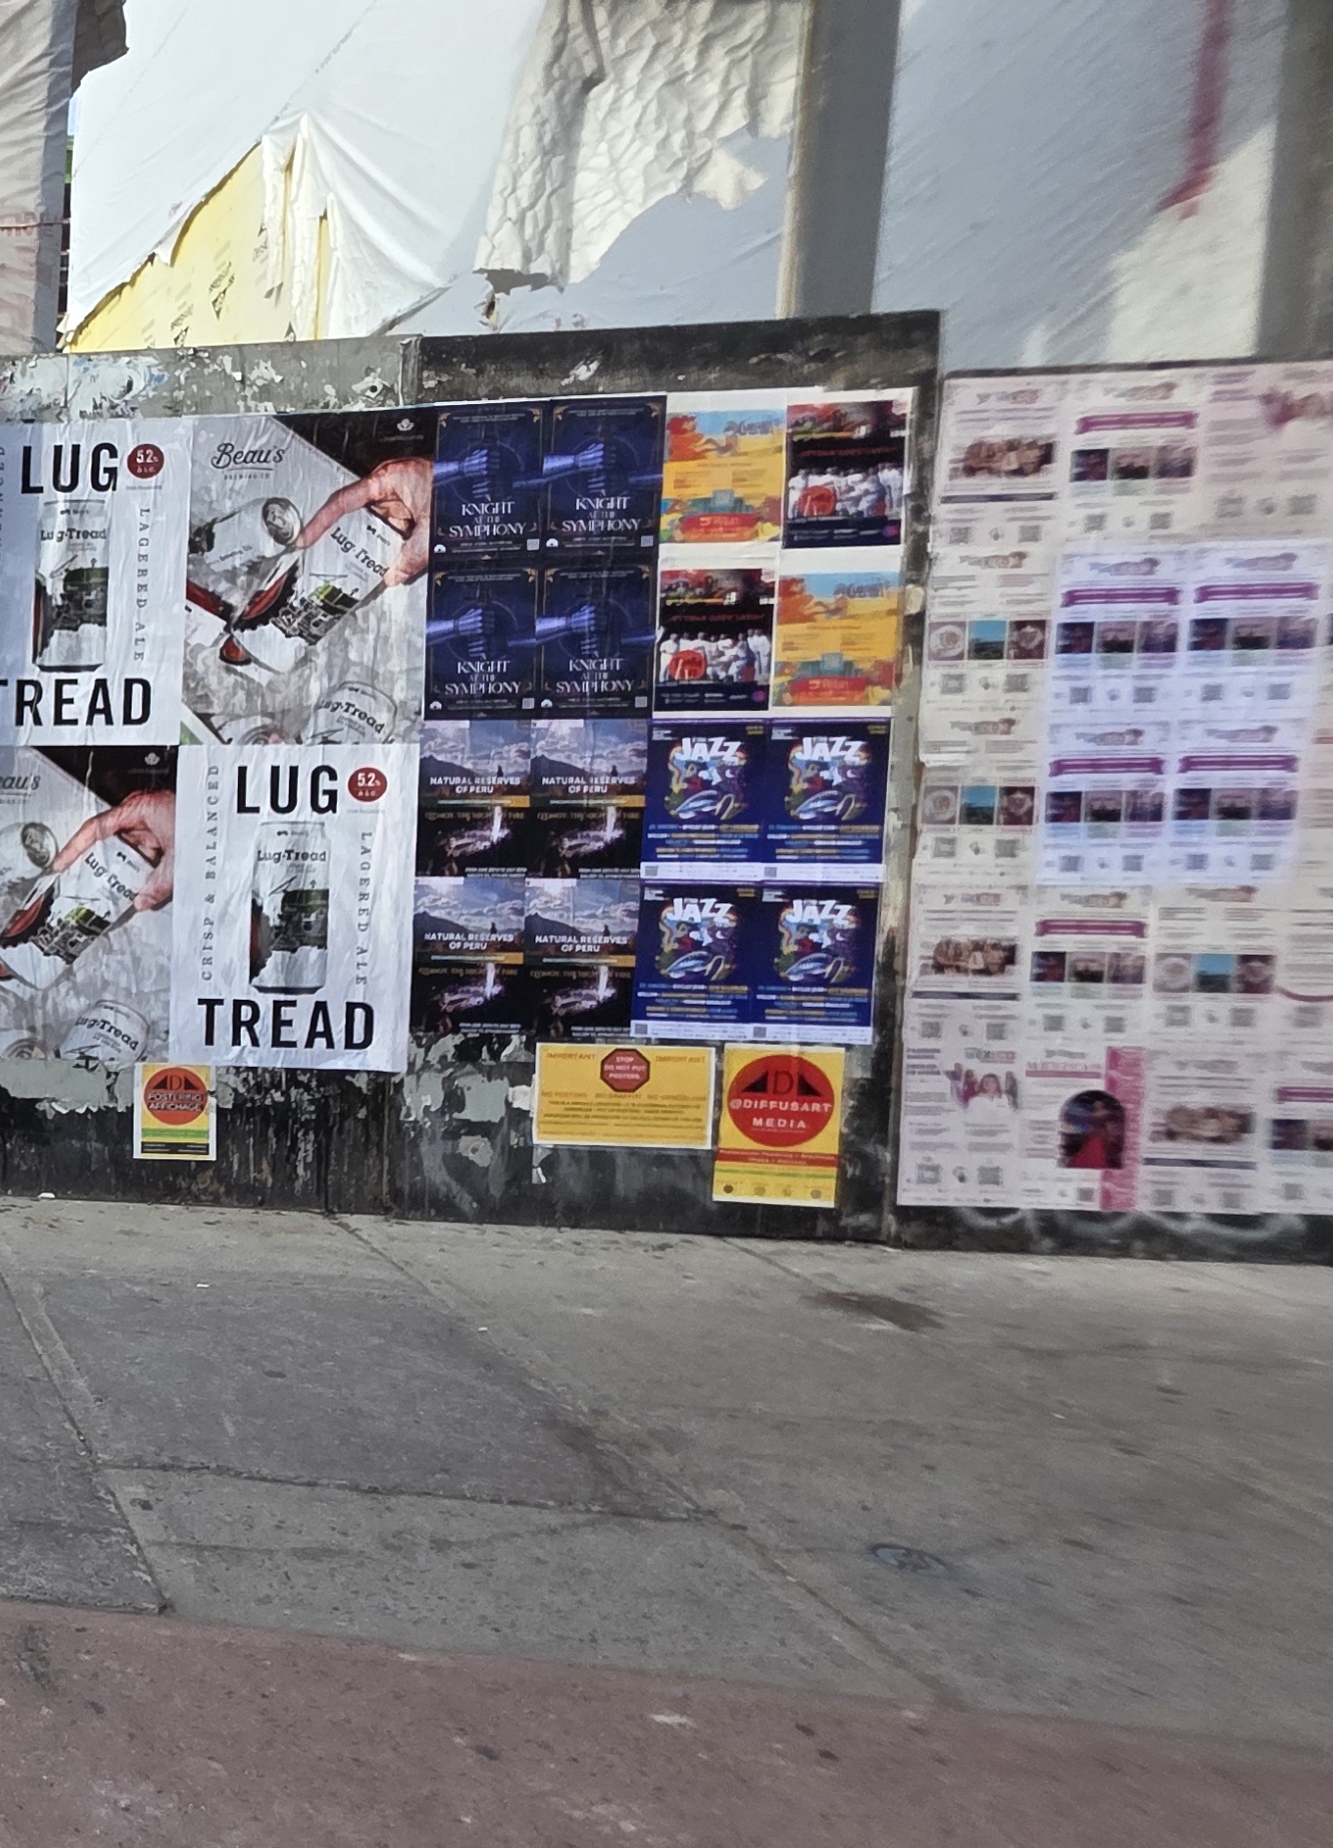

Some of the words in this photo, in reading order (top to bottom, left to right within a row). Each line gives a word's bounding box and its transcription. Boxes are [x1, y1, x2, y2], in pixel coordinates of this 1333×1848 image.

[210, 442, 286, 469] Beau's
[21, 442, 118, 494] LUG
[461, 502, 516, 516] KNIGHT
[576, 497, 631, 511] KNIGHT
[449, 523, 527, 537] SYMPHONY
[562, 519, 642, 532] SYMPHONY
[136, 508, 151, 609] LAGERED
[133, 622, 146, 661] ALE
[457, 660, 511, 674] KNIGHT
[569, 659, 624, 672] KNIGHT
[444, 682, 521, 695] SYMPHONY
[556, 680, 633, 693] SYMPHONY
[675, 736, 744, 765] JAZZ
[795, 736, 867, 765] JAZZ
[430, 777, 472, 785] NATURAL
[542, 776, 586, 785] NATURAL
[236, 765, 338, 815] LUG
[469, 786, 494, 794] PERU
[583, 786, 608, 794] PERU
[204, 765, 220, 880] BALANCED
[358, 831, 372, 932] LAGERED
[666, 898, 733, 926] JAZZ
[785, 899, 853, 927] JAZZ
[425, 933, 466, 942] NATURAL
[535, 935, 579, 944] NATURAL
[201, 917, 215, 981] CRISP
[463, 942, 487, 950] PERU
[575, 944, 600, 952] PERU
[356, 946, 368, 985] ALE
[197, 998, 375, 1051] TREAD
[148, 1092, 202, 1101] POSTERING
[149, 1102, 201, 1111] AFFICHAGE
[730, 1099, 832, 1112] @DIFFUSART
[752, 1117, 807, 1129] MEDIA
